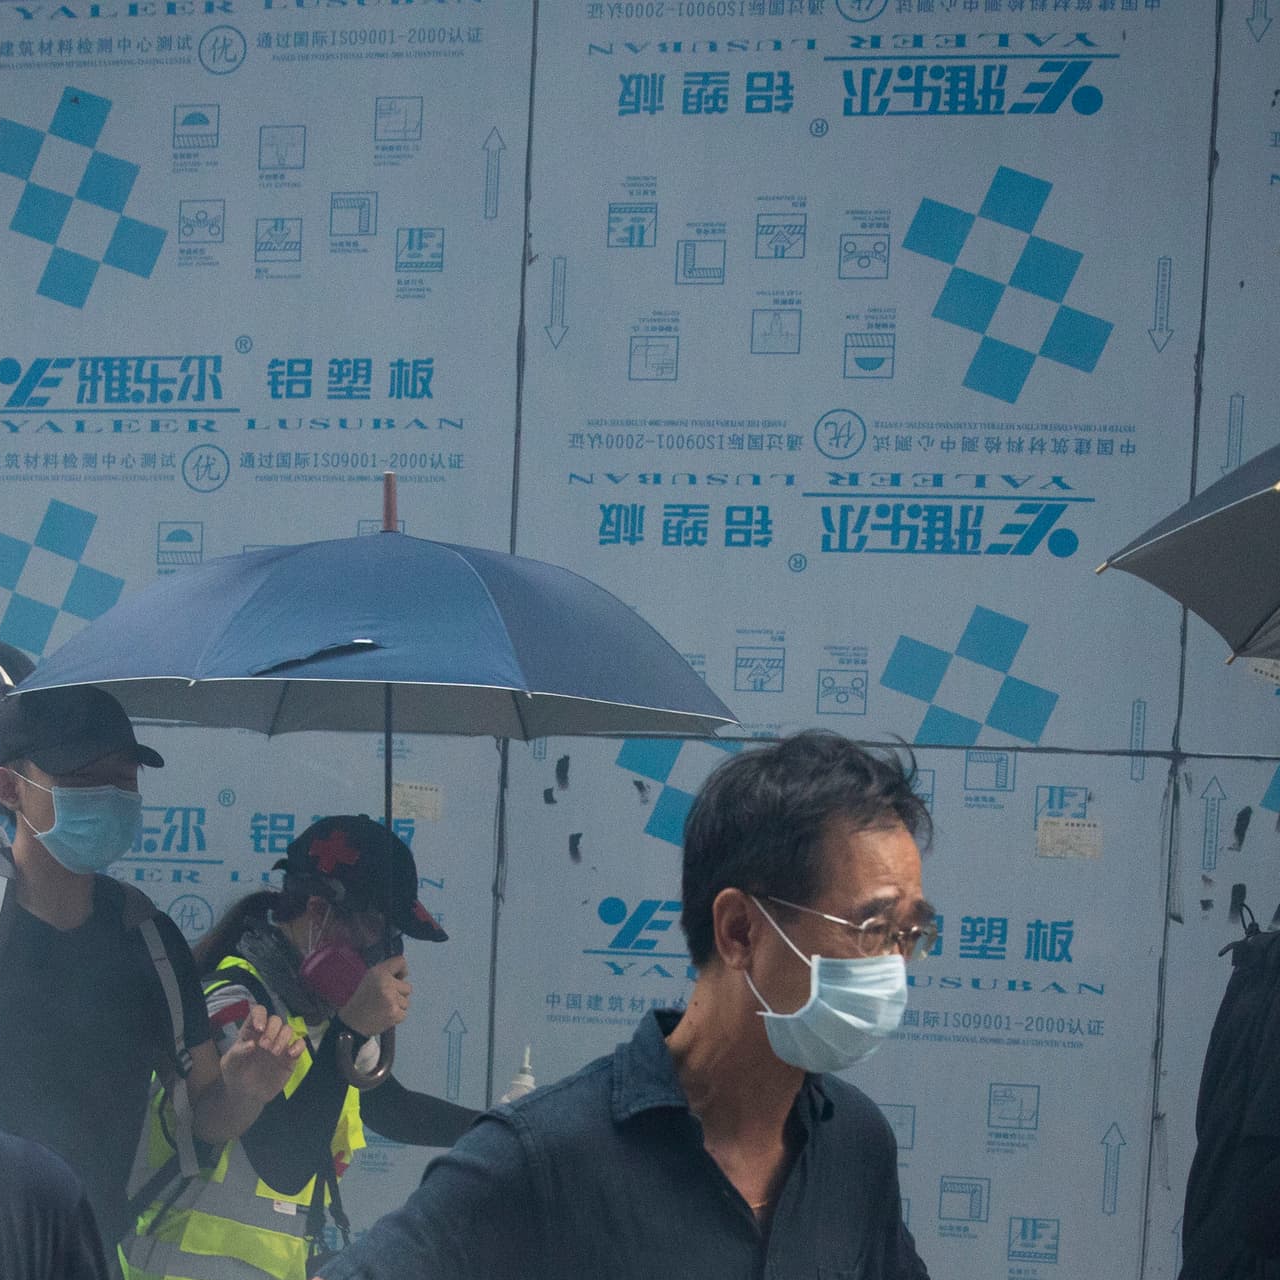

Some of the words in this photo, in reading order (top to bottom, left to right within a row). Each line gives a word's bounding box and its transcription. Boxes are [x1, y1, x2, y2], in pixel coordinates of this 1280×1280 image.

[256, 27, 483, 49] 通过国际ISO9001-2000认证
[587, 39, 817, 55] LUSUBAN
[846, 32, 1099, 49] YALEER
[618, 71, 794, 116] 铝塑板
[266, 357, 435, 400] 铝塑板
[0, 417, 220, 434] YALEER
[244, 417, 464, 431] LUSUBAN
[568, 433, 803, 452] 通过国际ISO9001-2000认证
[872, 435, 1136, 456] 中国建筑材料检测中心测试
[239, 451, 464, 470] 通过国际ISO9001-2000认证
[568, 471, 796, 487] LUSUBAN
[826, 472, 1074, 490] YALEER
[597, 503, 773, 547] 铝塑板
